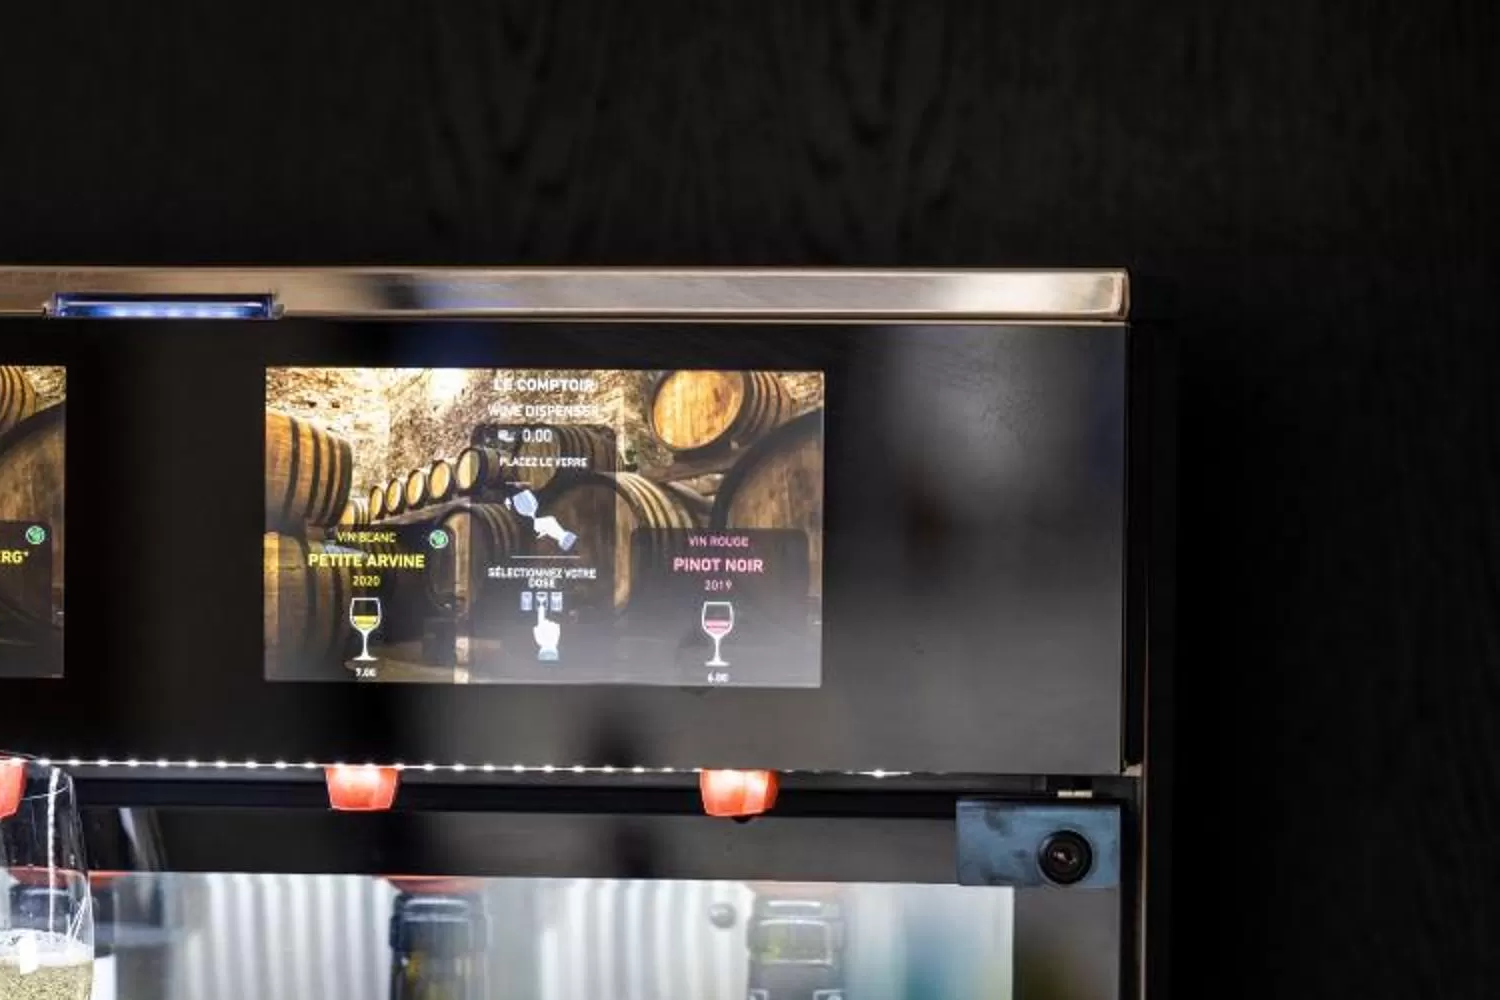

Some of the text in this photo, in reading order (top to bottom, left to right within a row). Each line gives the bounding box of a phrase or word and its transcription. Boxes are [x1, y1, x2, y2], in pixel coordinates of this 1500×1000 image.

[493, 378, 595, 392] LE COMPTOIR
[522, 428, 553, 443] 0.00
[500, 457, 588, 468] PLACEZ LE VERRE
[337, 531, 397, 543] VIN BLANC
[688, 536, 750, 548] VIN ROUGE
[308, 553, 426, 569] PETITE ARVINE
[673, 557, 765, 573] PINOT NOIR
[564, 567, 597, 579] VOTRE
[352, 575, 381, 587] 2020
[528, 578, 556, 589] DOSE
[704, 579, 733, 591] 2019
